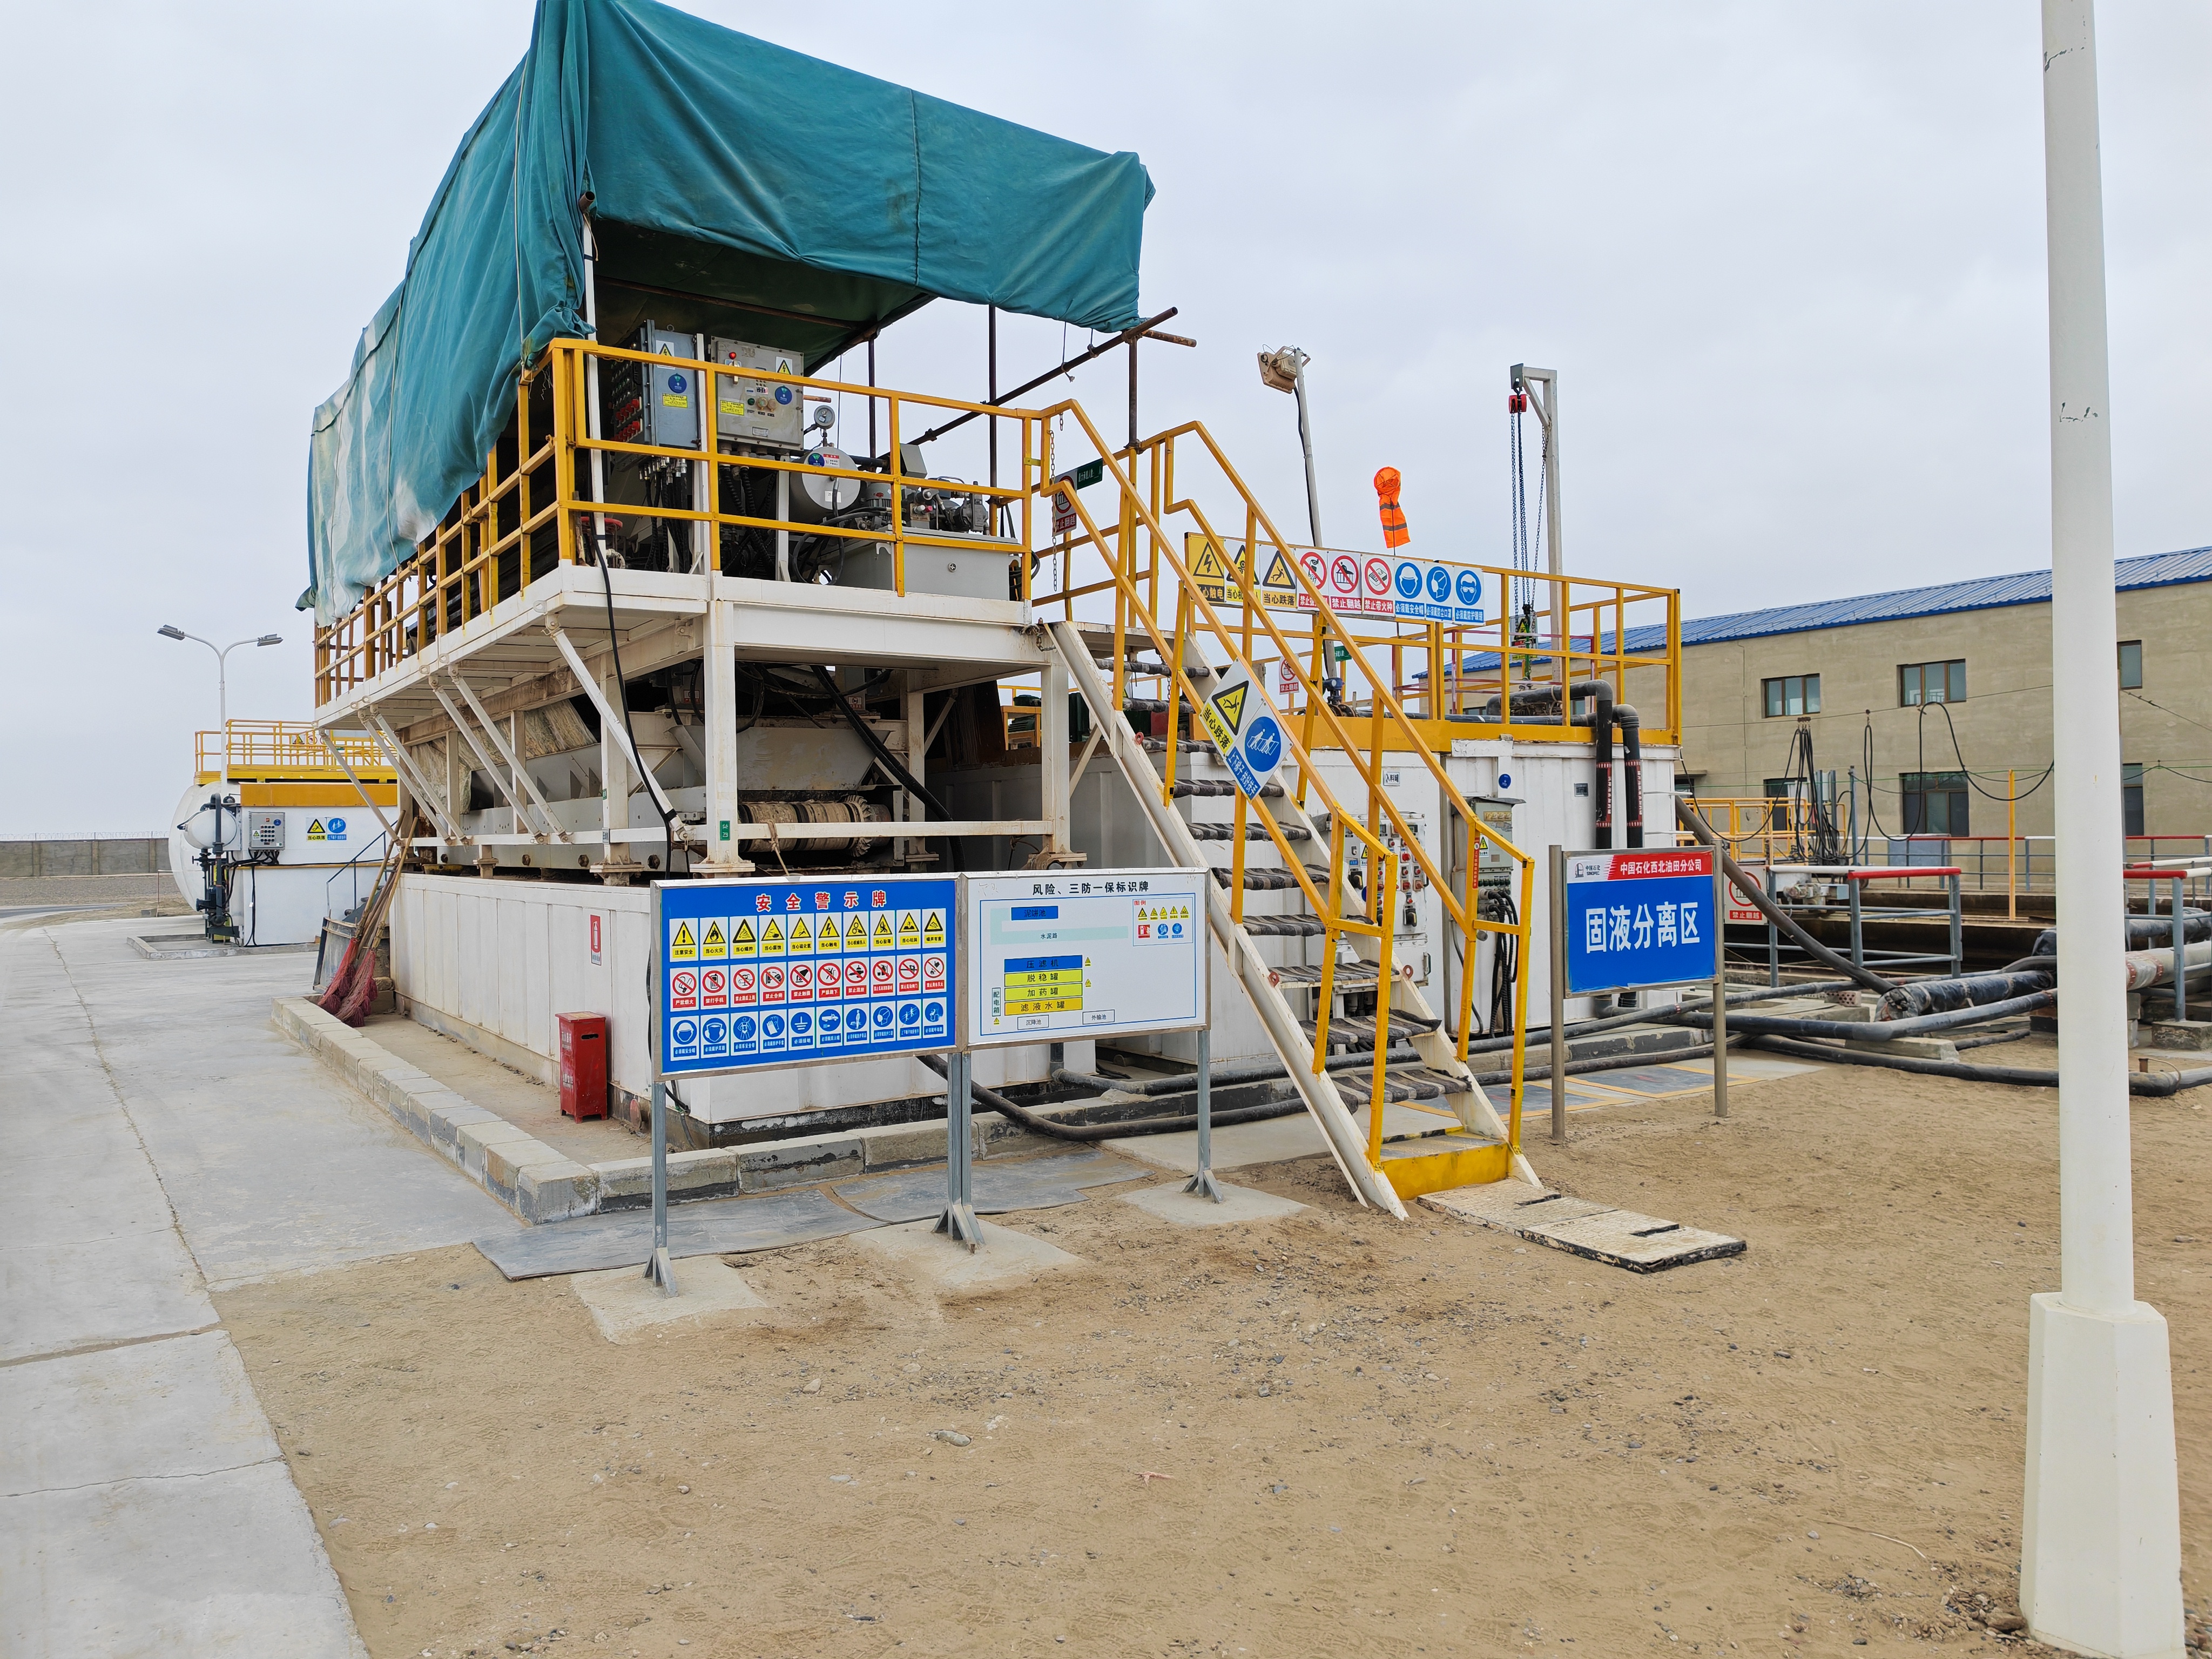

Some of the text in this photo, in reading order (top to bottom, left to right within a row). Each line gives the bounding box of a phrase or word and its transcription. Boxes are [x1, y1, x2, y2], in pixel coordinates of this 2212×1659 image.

[1199, 586, 1224, 599] 心触电
[1264, 593, 1295, 605] 当心跌落
[1332, 597, 1361, 609] 禁止翻越
[1365, 599, 1392, 611] 禁止带火种
[1395, 603, 1424, 615] 必须戴安全帽
[1426, 606, 1452, 618] 必须戴防尘口罩
[1455, 611, 1483, 622] 必须戴防护眼镜
[1280, 683, 1298, 691] 禁止翻越
[1203, 707, 1231, 749] 当心跌落
[1620, 859, 1702, 876] 中国石化西北油田分公司
[1032, 881, 1149, 895] 风险、三防一保标识牌
[756, 890, 887, 913] 安全警示牌
[1024, 909, 1046, 918] 泥饼池
[1586, 901, 1700, 954] 固液分离区
[1027, 959, 1059, 968] 压滤机
[1027, 973, 1059, 982] 脱稳罐
[1027, 987, 1059, 997] 加药罐
[1020, 1001, 1065, 1012] 滤液水罐
